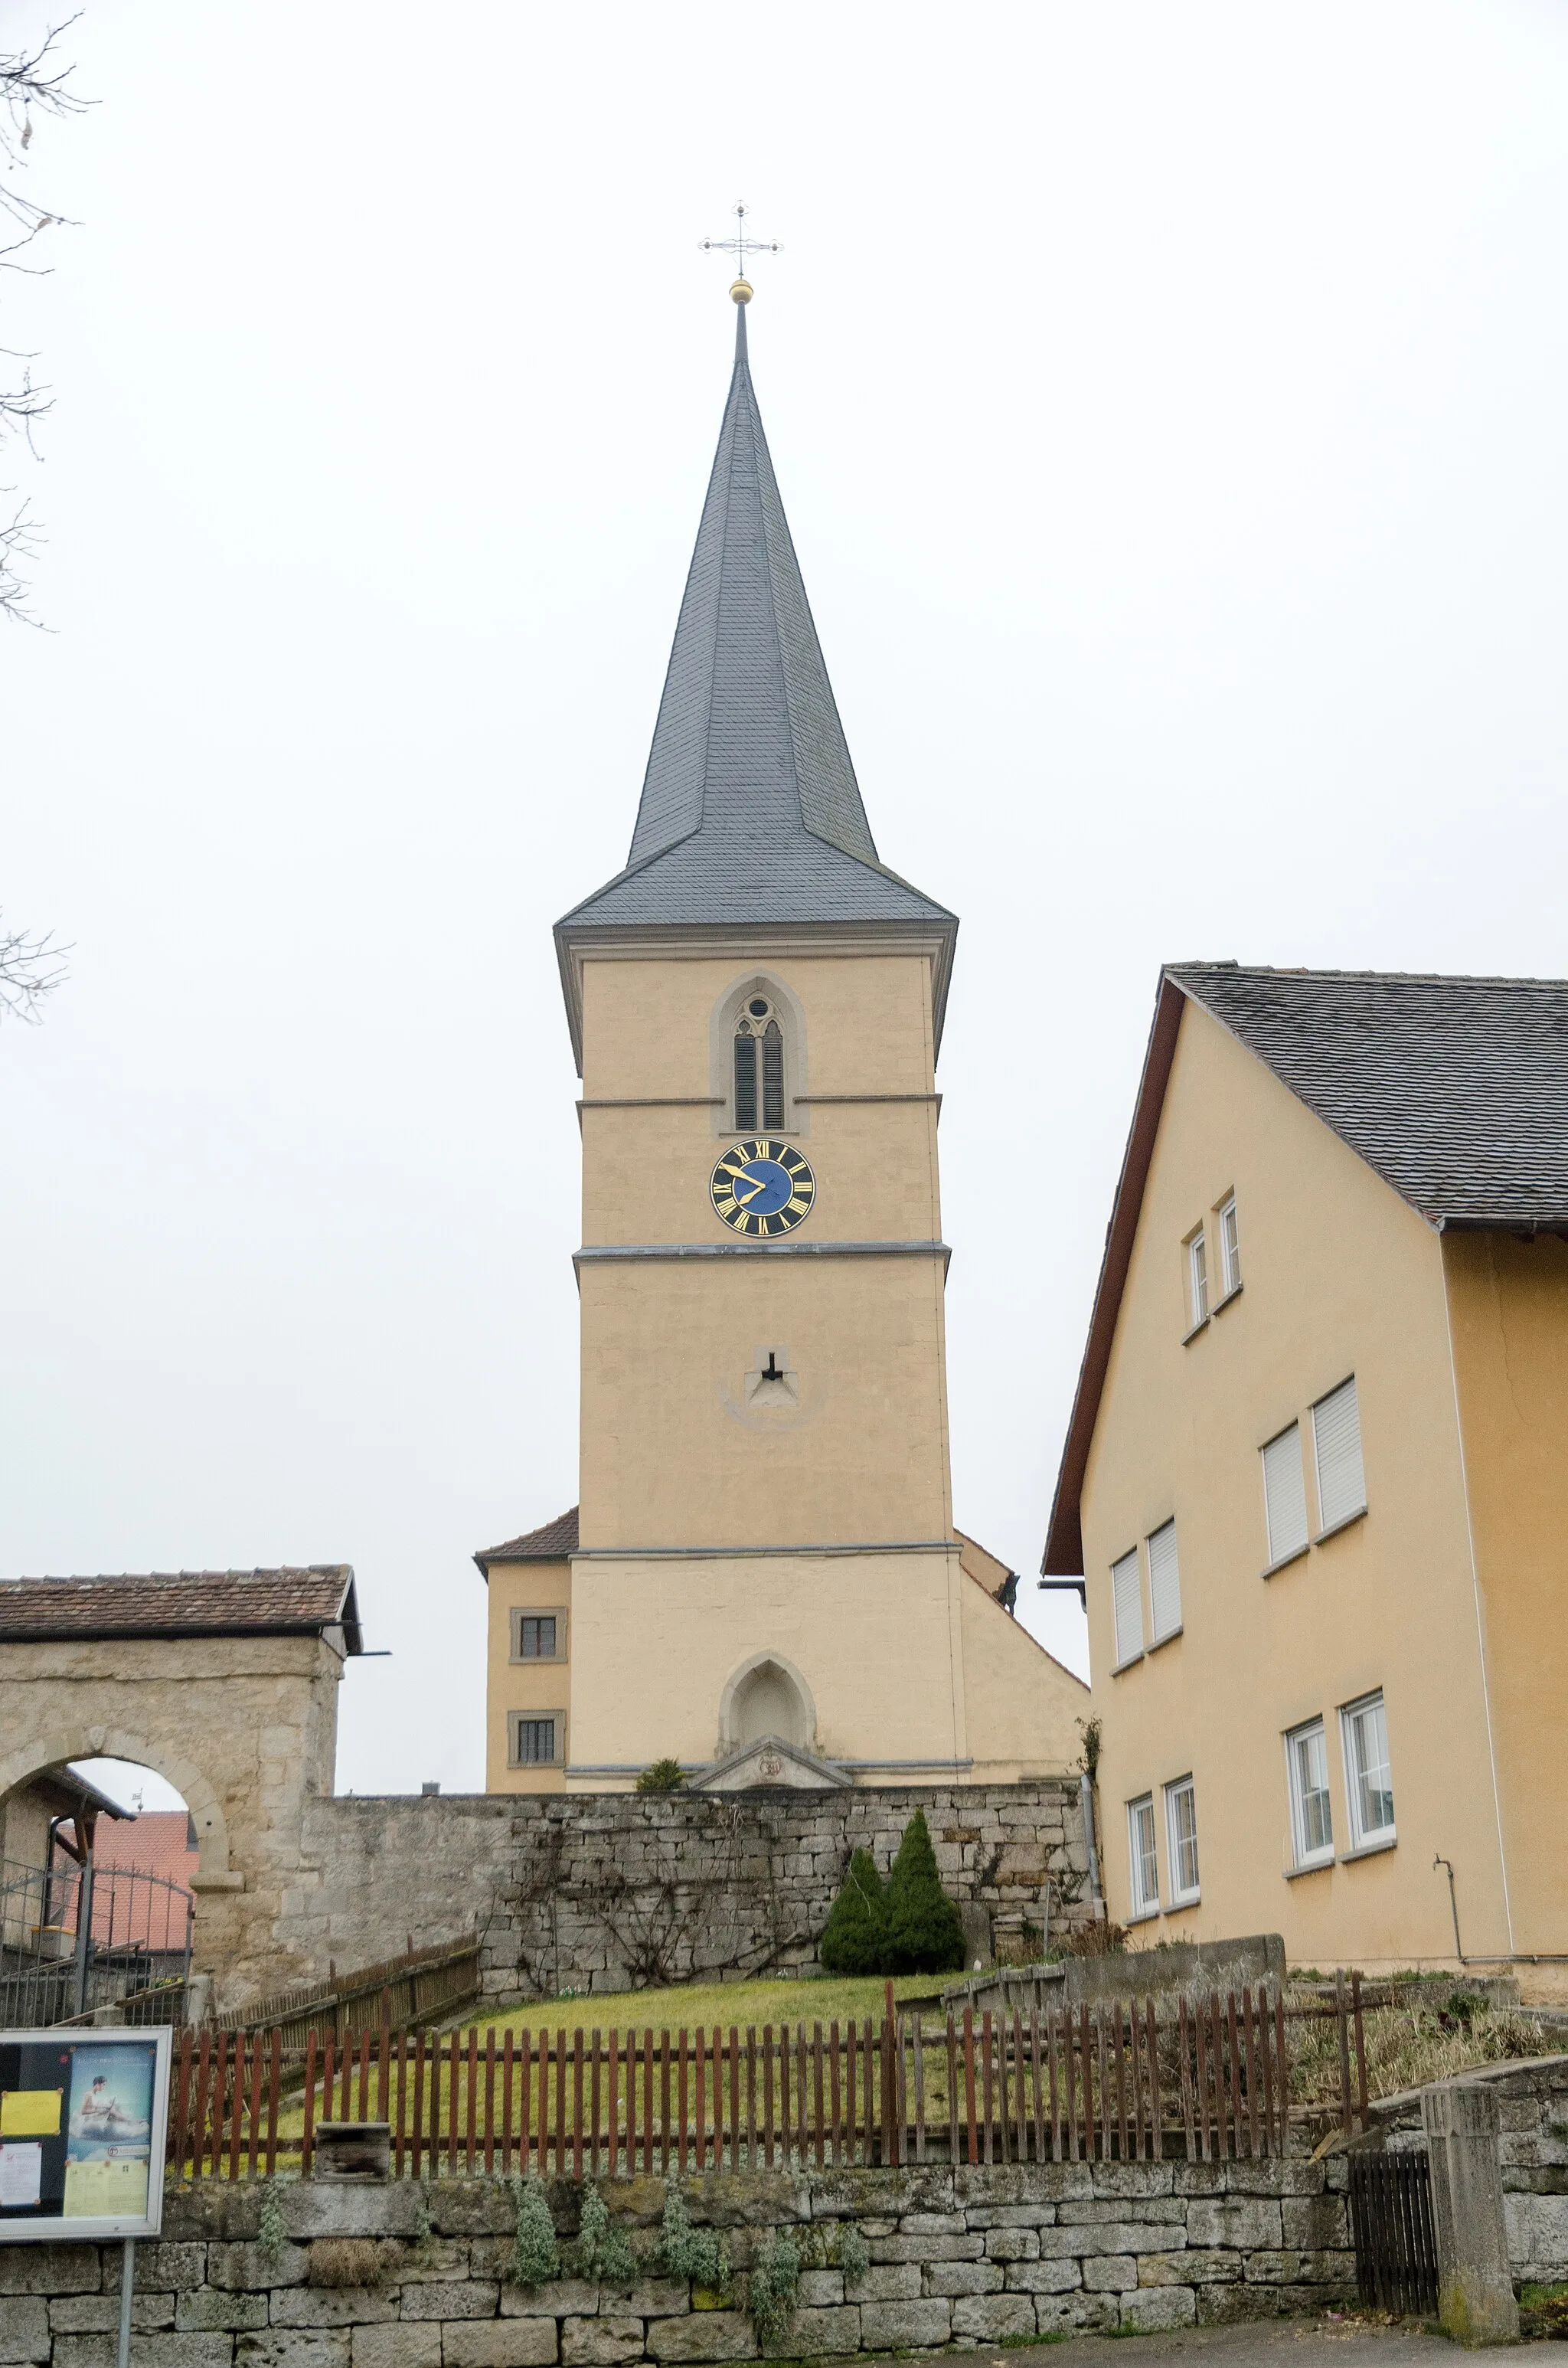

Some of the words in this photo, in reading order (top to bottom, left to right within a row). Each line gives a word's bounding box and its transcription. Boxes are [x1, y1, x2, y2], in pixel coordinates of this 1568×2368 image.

[733, 1146, 750, 1164] XI
[755, 1141, 769, 1158] XII
[776, 1146, 789, 1163] I
[789, 1161, 806, 1175] II
[713, 1182, 732, 1193] IX
[794, 1182, 812, 1192] III
[717, 1198, 737, 1218] VIII
[787, 1197, 809, 1215] IIII
[733, 1212, 750, 1231] VII
[758, 1217, 769, 1235] VI
[779, 1213, 792, 1228] V
